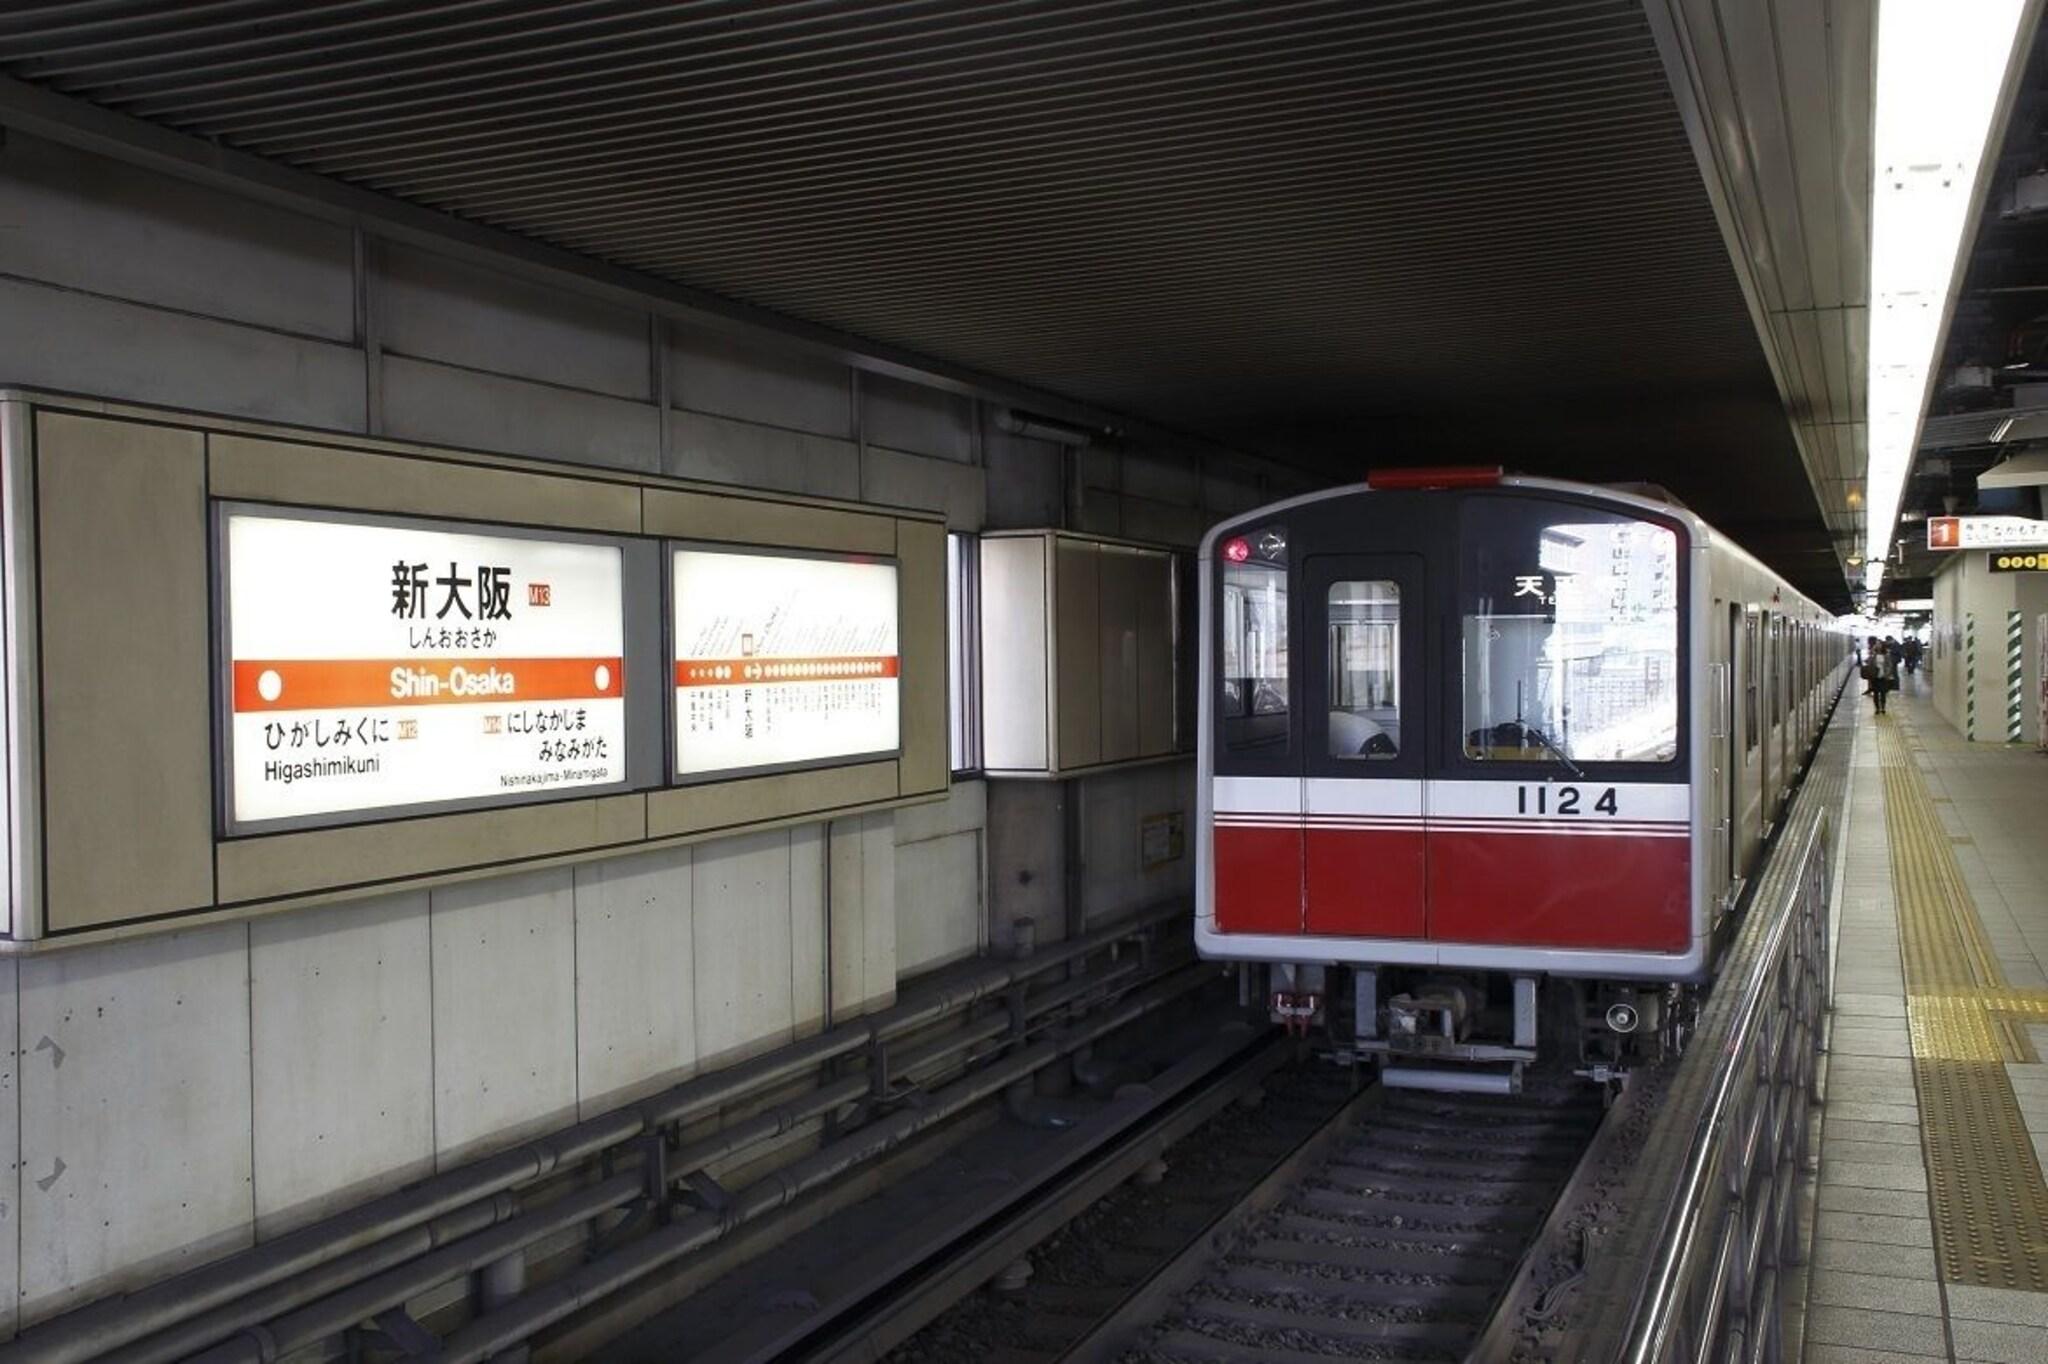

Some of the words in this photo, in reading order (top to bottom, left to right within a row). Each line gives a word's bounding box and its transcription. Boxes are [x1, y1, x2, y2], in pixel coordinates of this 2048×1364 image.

[391, 560, 512, 620] 新大阪
[409, 626, 497, 649] しんおおさか
[390, 666, 515, 698] Shin-Osaka
[264, 717, 389, 750] ひがしみくに
[507, 708, 587, 734] にしなかじま
[538, 736, 608, 762] みなみがた
[264, 754, 380, 784] Higashimikuni
[1518, 786, 1618, 816] 1124
